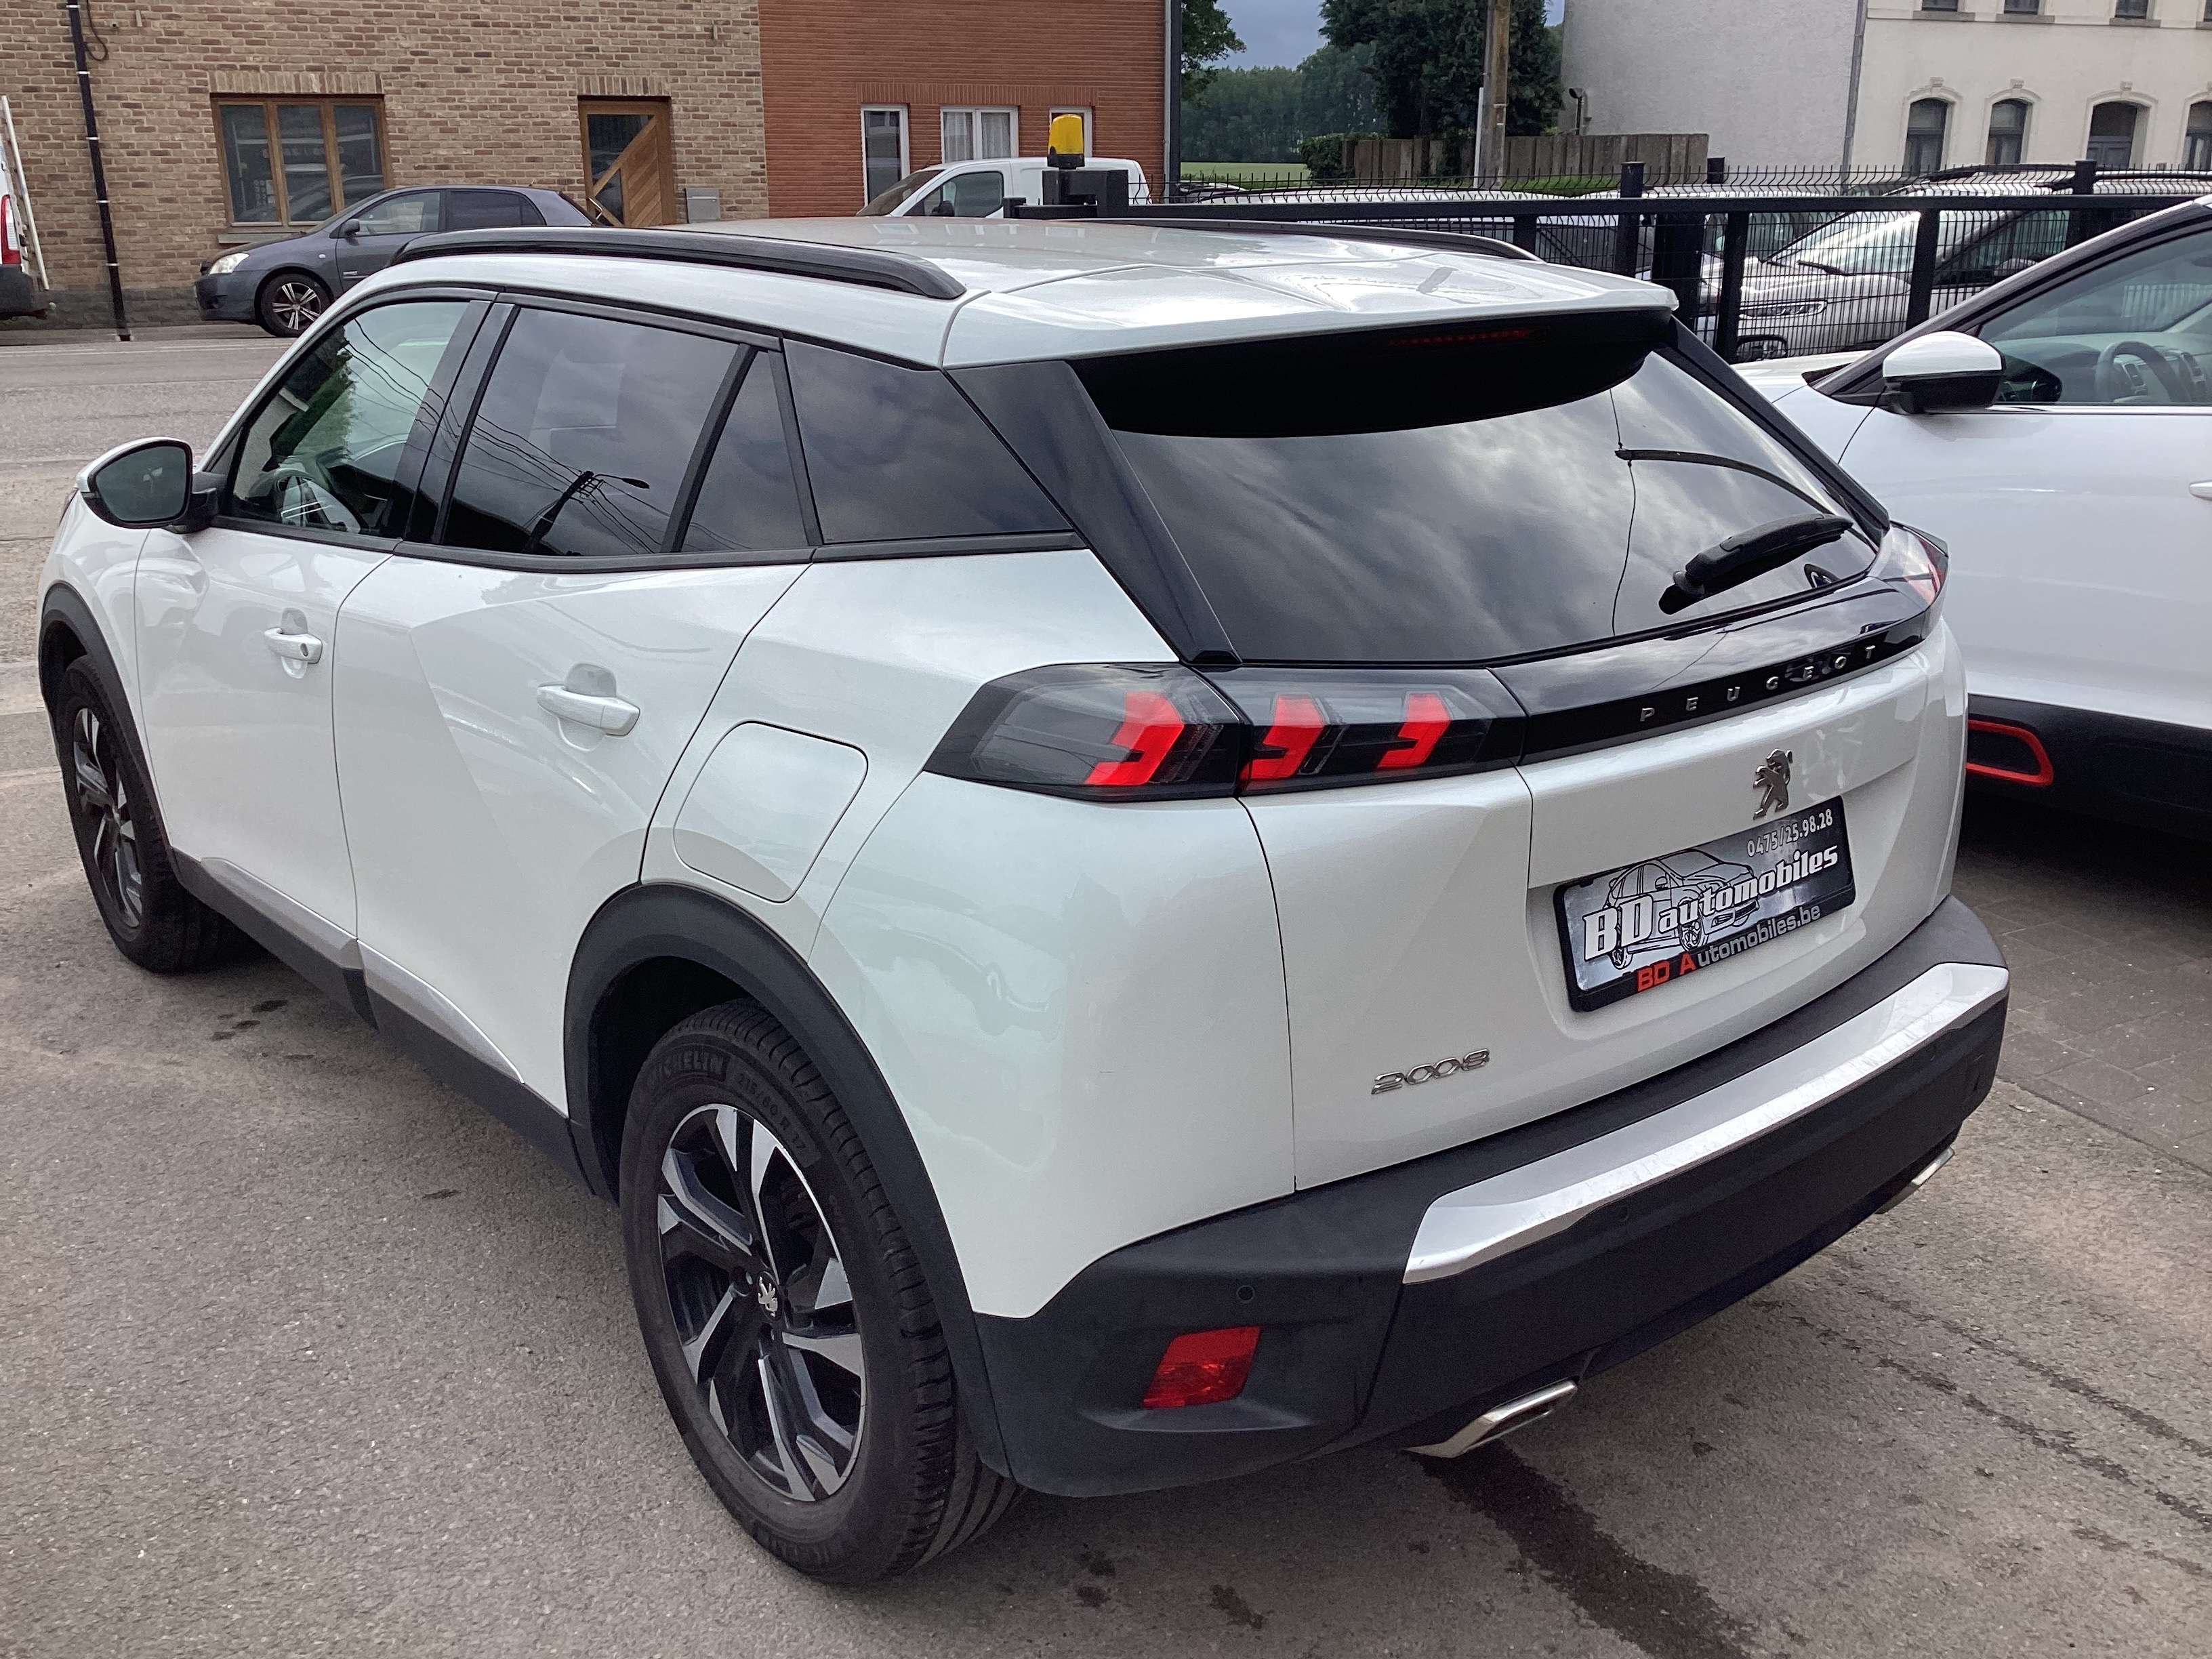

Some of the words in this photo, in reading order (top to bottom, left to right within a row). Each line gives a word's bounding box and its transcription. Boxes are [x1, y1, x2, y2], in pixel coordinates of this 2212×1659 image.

[1639, 645, 1876, 722] PEUGEOT
[1746, 808, 1833, 858] 0475/25.98.28
[1582, 893, 1654, 962] BD
[1658, 844, 1839, 934] automobiles
[1637, 962, 1670, 992] BD
[1371, 1048, 1490, 1095] 2008
